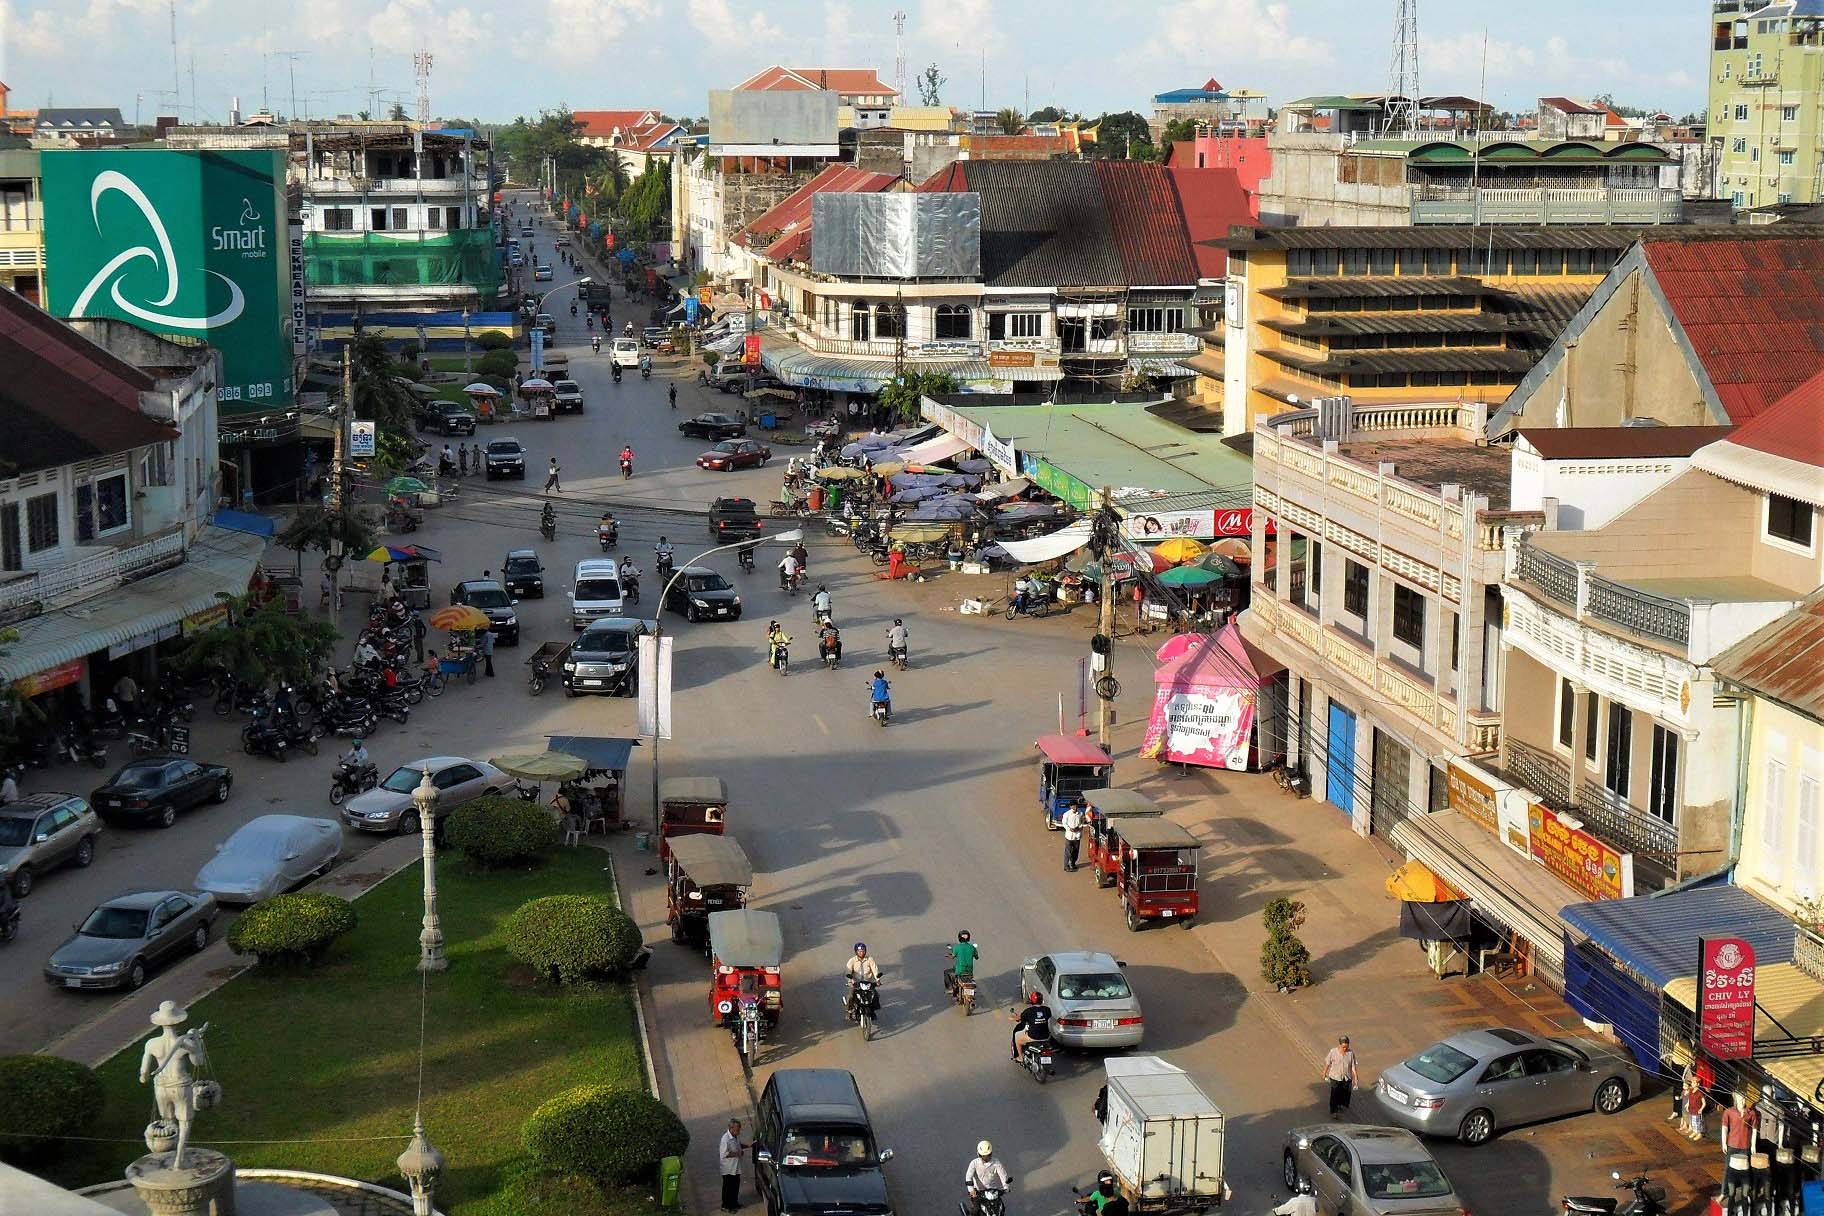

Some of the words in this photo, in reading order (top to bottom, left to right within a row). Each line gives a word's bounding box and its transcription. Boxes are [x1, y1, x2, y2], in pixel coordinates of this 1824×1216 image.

[212, 225, 265, 250] Smart
[241, 249, 266, 258] mobile
[292, 239, 303, 297] SEKMEAS
[294, 302, 305, 343] HOTEL
[249, 383, 272, 398] 093
[1232, 756, 1243, 765] qb
[1708, 991, 1732, 1001] CHIV
[1738, 990, 1751, 1000] LY
